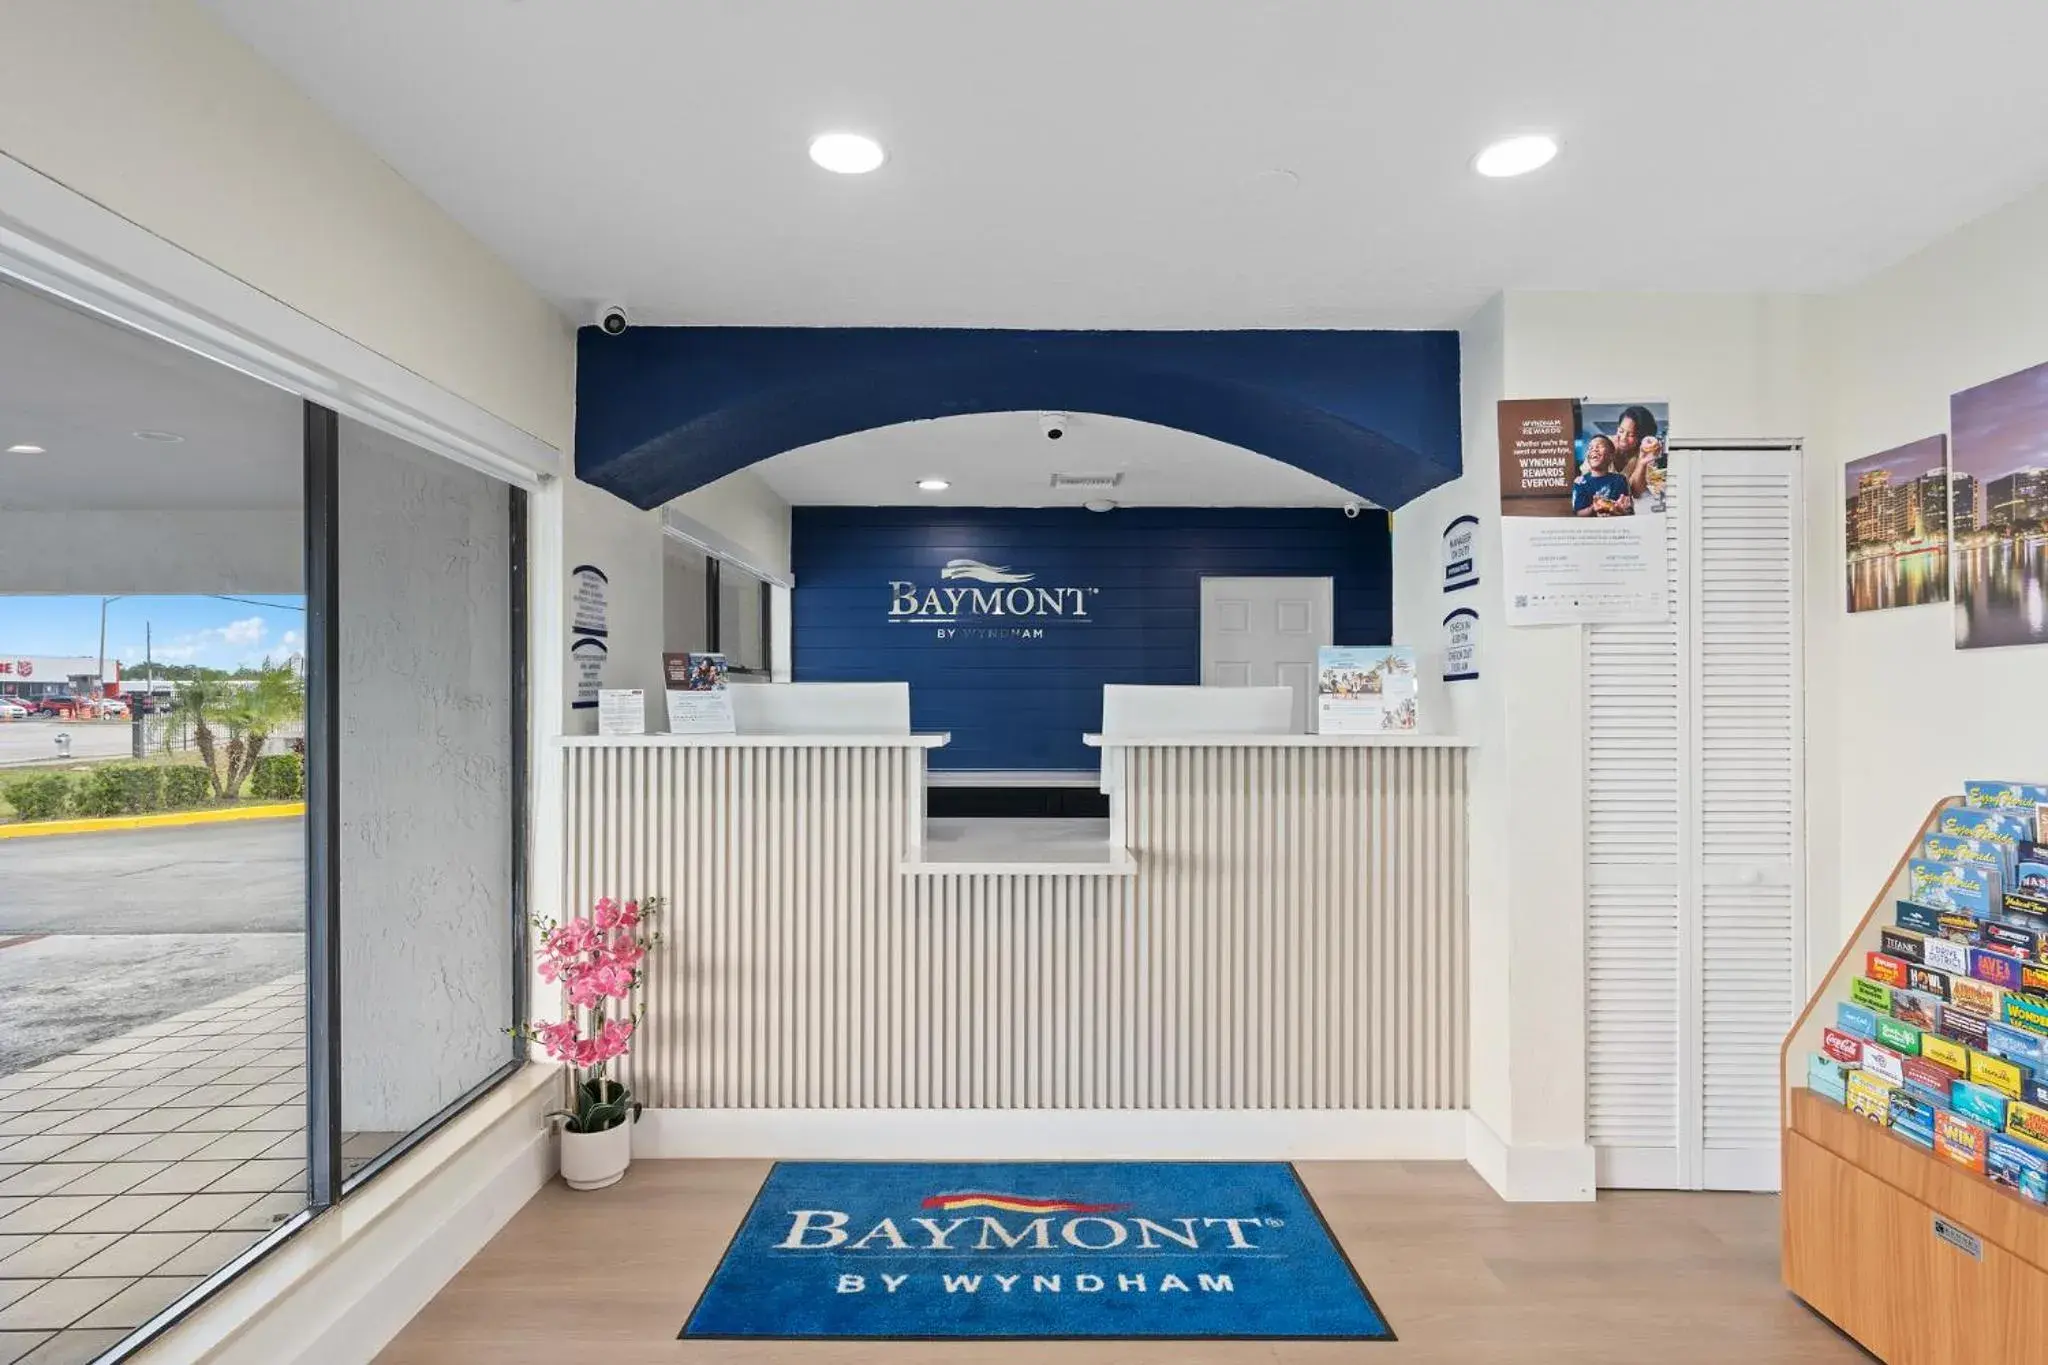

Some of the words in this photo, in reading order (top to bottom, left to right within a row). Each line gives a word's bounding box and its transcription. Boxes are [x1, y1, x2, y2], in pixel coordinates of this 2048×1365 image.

[1519, 458, 1566, 467] WYNDHAM
[1523, 467, 1564, 477] REWARDS
[1521, 477, 1568, 488] EVERYONE.
[937, 629, 956, 639] BY
[1942, 871, 1981, 891] Florida
[1886, 938, 1918, 952] TITANIC
[836, 1274, 910, 1293] BY
[943, 1274, 1235, 1293] WYNDHAM
